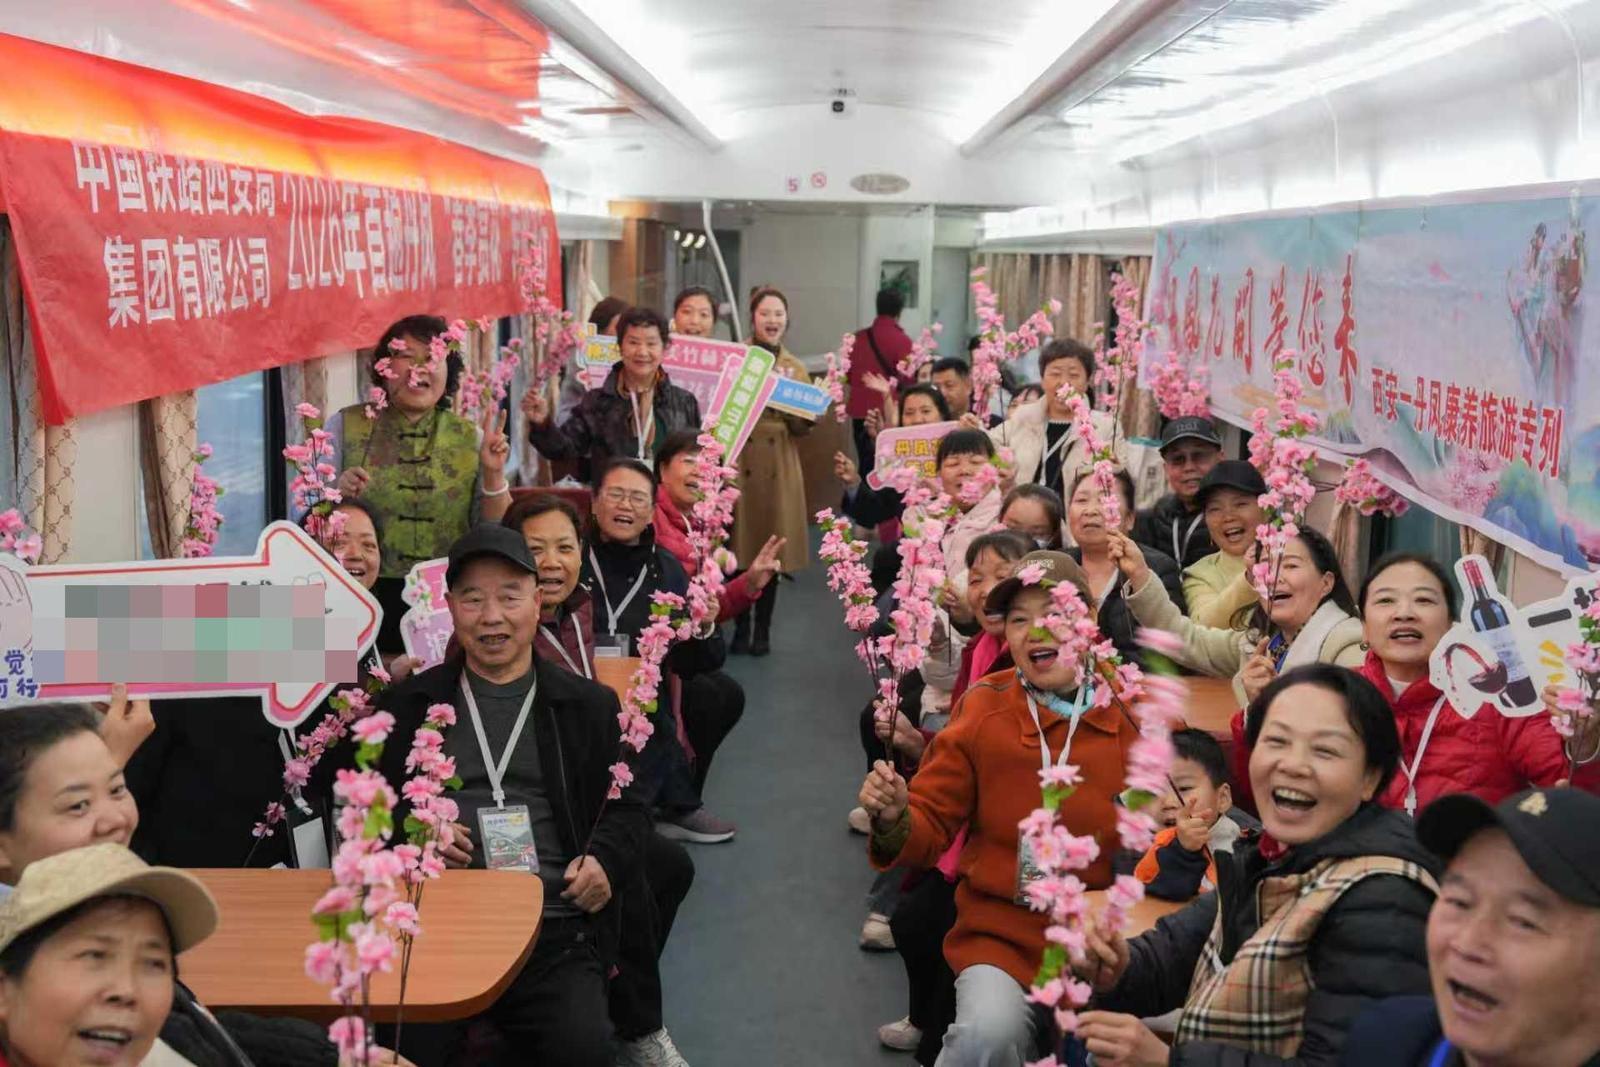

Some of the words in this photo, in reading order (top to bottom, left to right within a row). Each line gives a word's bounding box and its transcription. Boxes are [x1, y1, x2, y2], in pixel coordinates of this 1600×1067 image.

[788, 178, 799, 193] 5
[104, 235, 270, 329] 集团有限公司
